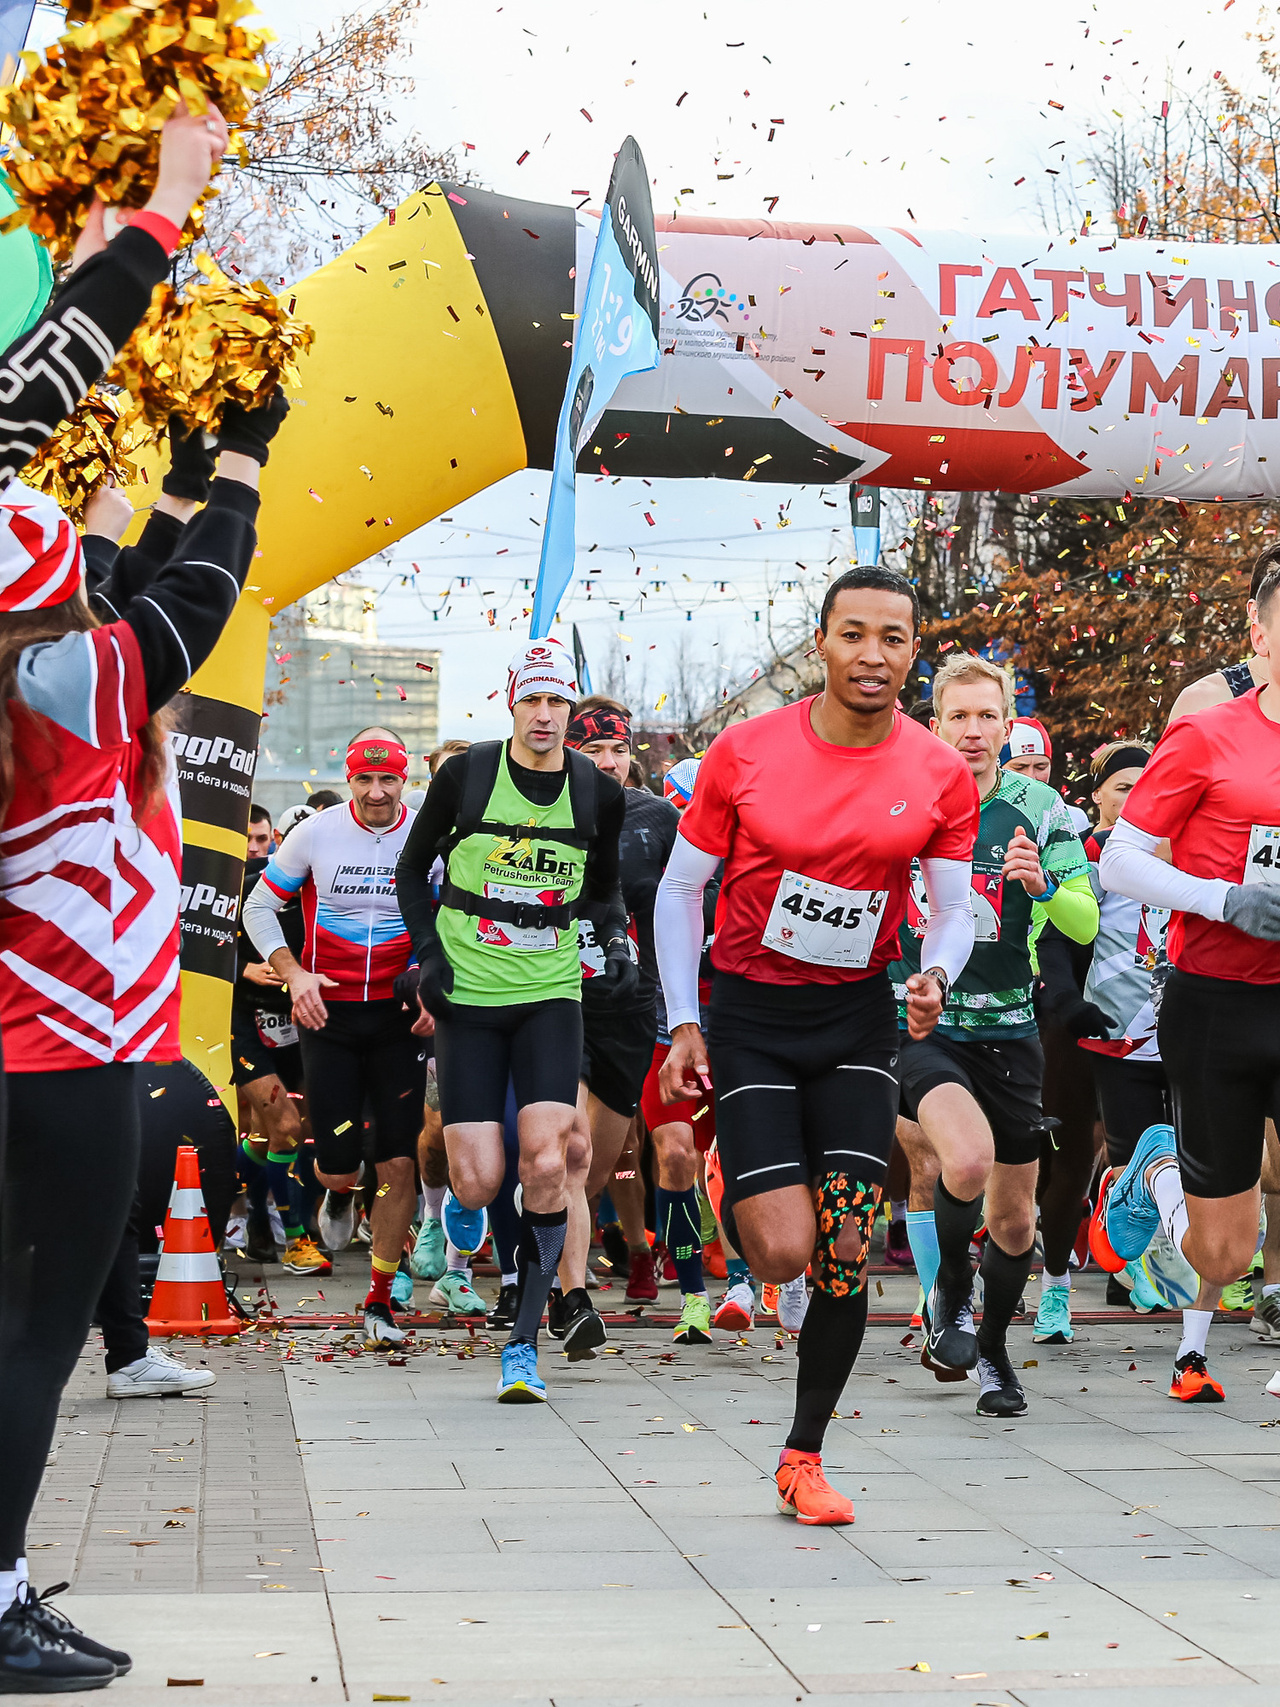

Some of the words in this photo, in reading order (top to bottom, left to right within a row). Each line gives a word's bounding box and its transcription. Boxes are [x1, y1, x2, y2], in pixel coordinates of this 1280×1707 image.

[617, 196, 658, 303] GARMIN
[517, 675, 565, 690] GATCHINARUN
[197, 771, 221, 787] бега
[222, 780, 228, 790] и
[340, 866, 396, 876] ЖЕЛЕЗН
[484, 862, 548, 884] Petrushenko
[551, 875, 574, 887] Team
[986, 880, 998, 891] A
[178, 883, 239, 922] gPad
[868, 895, 880, 908] A
[781, 892, 863, 930] 4545
[179, 919, 203, 935] бега
[204, 926, 211, 936] и
